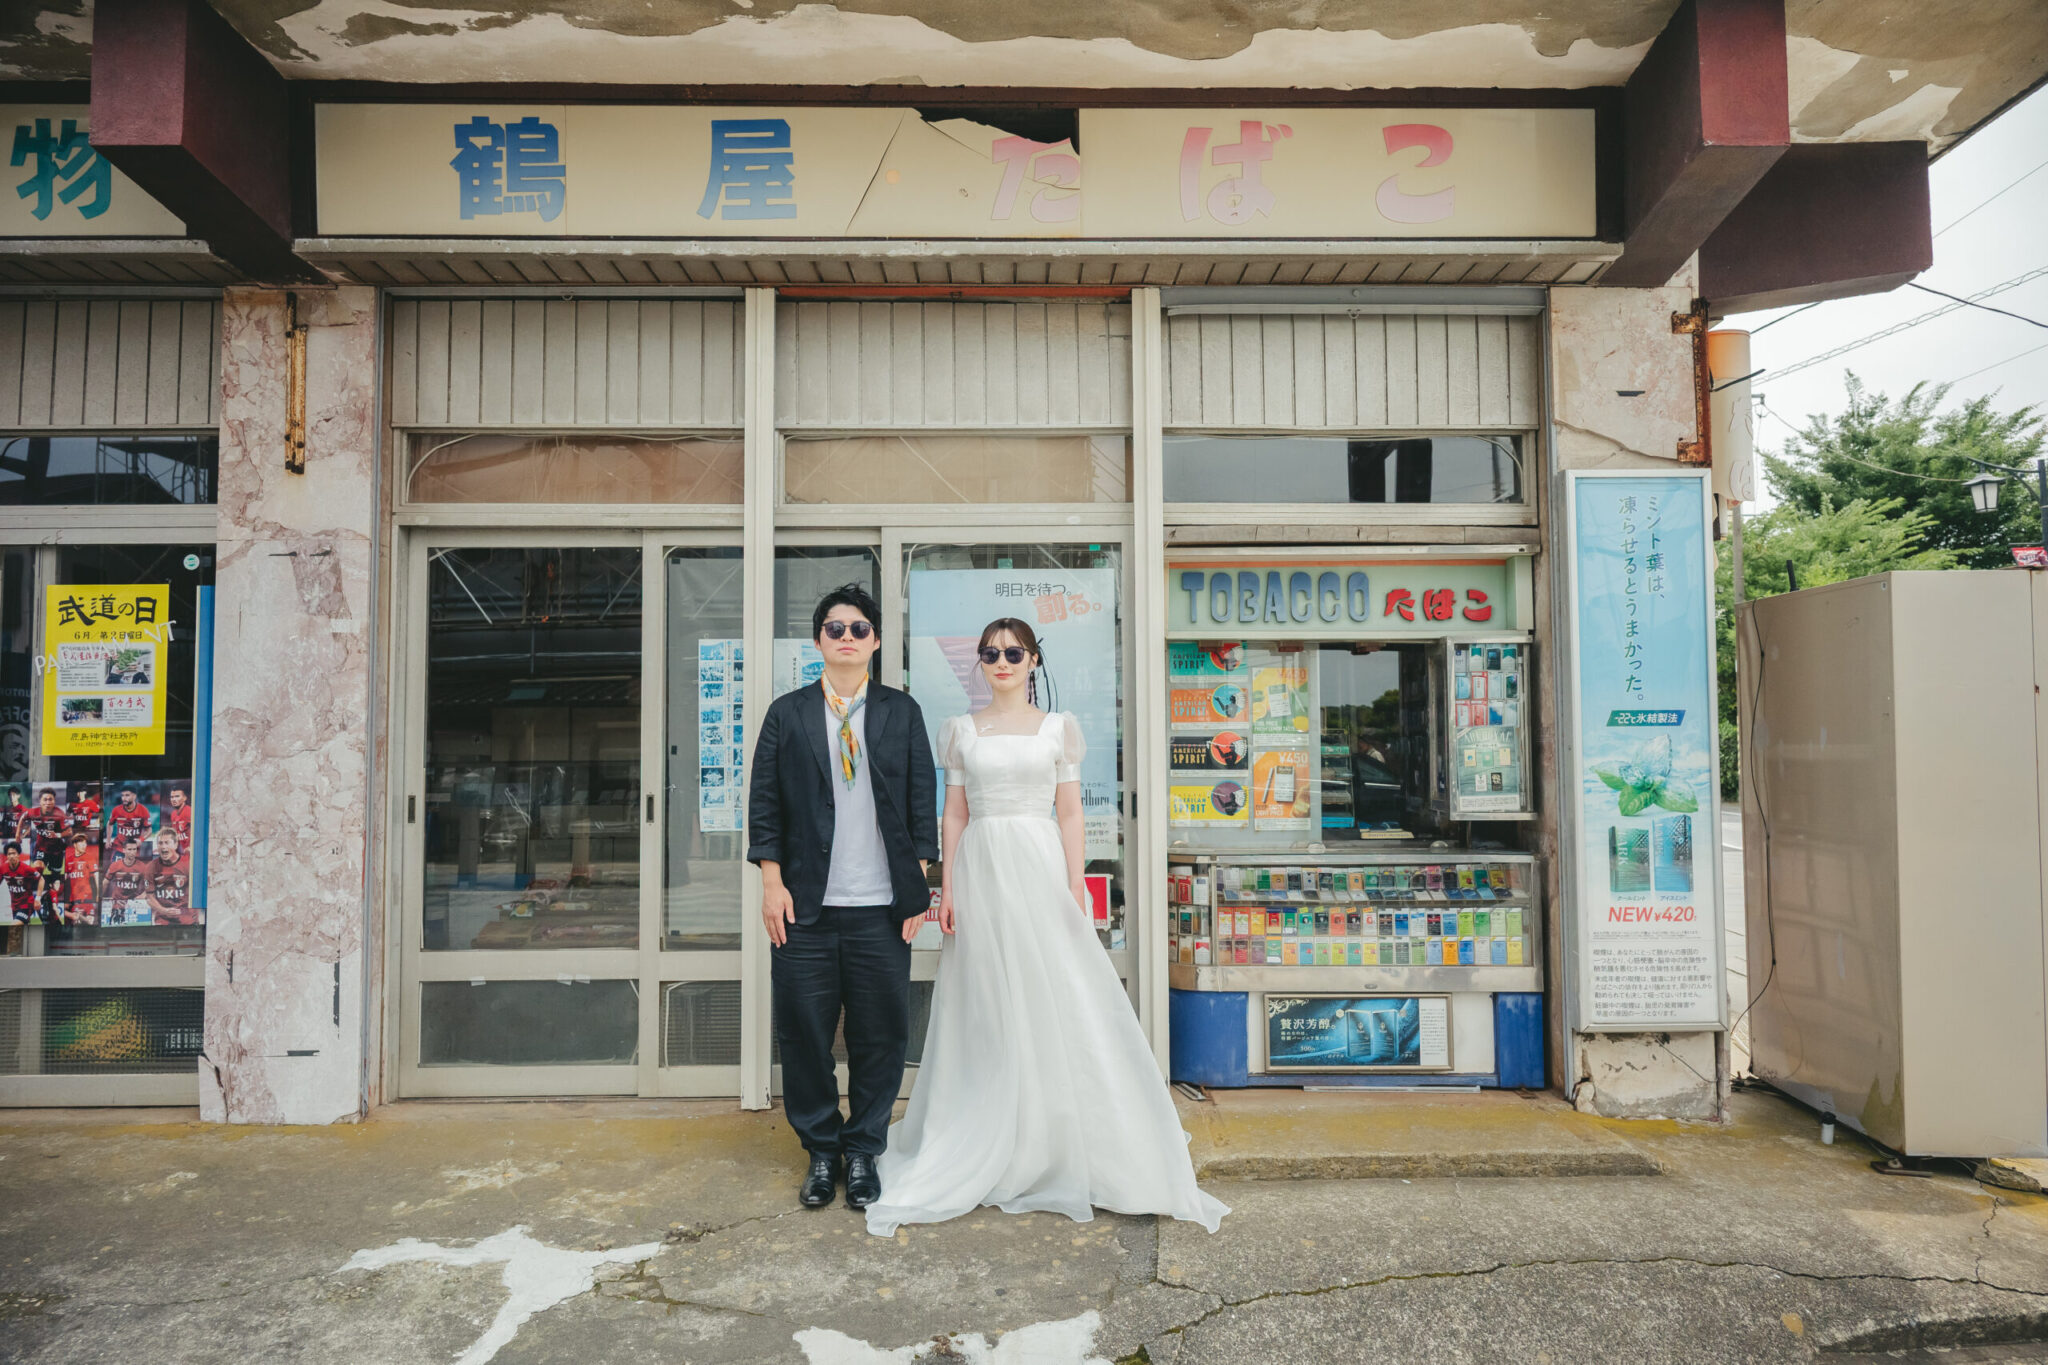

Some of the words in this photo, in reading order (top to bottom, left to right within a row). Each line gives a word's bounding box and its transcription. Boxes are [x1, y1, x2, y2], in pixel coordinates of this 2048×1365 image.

[9, 117, 112, 221] 物
[449, 115, 798, 223] 鶴屋
[1646, 495, 1665, 599] ミント葉は、
[995, 582, 1072, 597] 明日を待つ。
[1181, 571, 1371, 622] TOBACCO
[1618, 495, 1644, 701] 凍らせるとうまかった。
[58, 593, 158, 627] 武道の日
[1173, 754, 1206, 764] SPIRIT
[118, 828, 140, 837] LIXIL
[117, 881, 138, 890] LIXIL
[157, 889, 185, 900] LIXIL
[1608, 906, 1653, 922] NEW
[1280, 1018, 1337, 1030] 贅沢芳醇。
